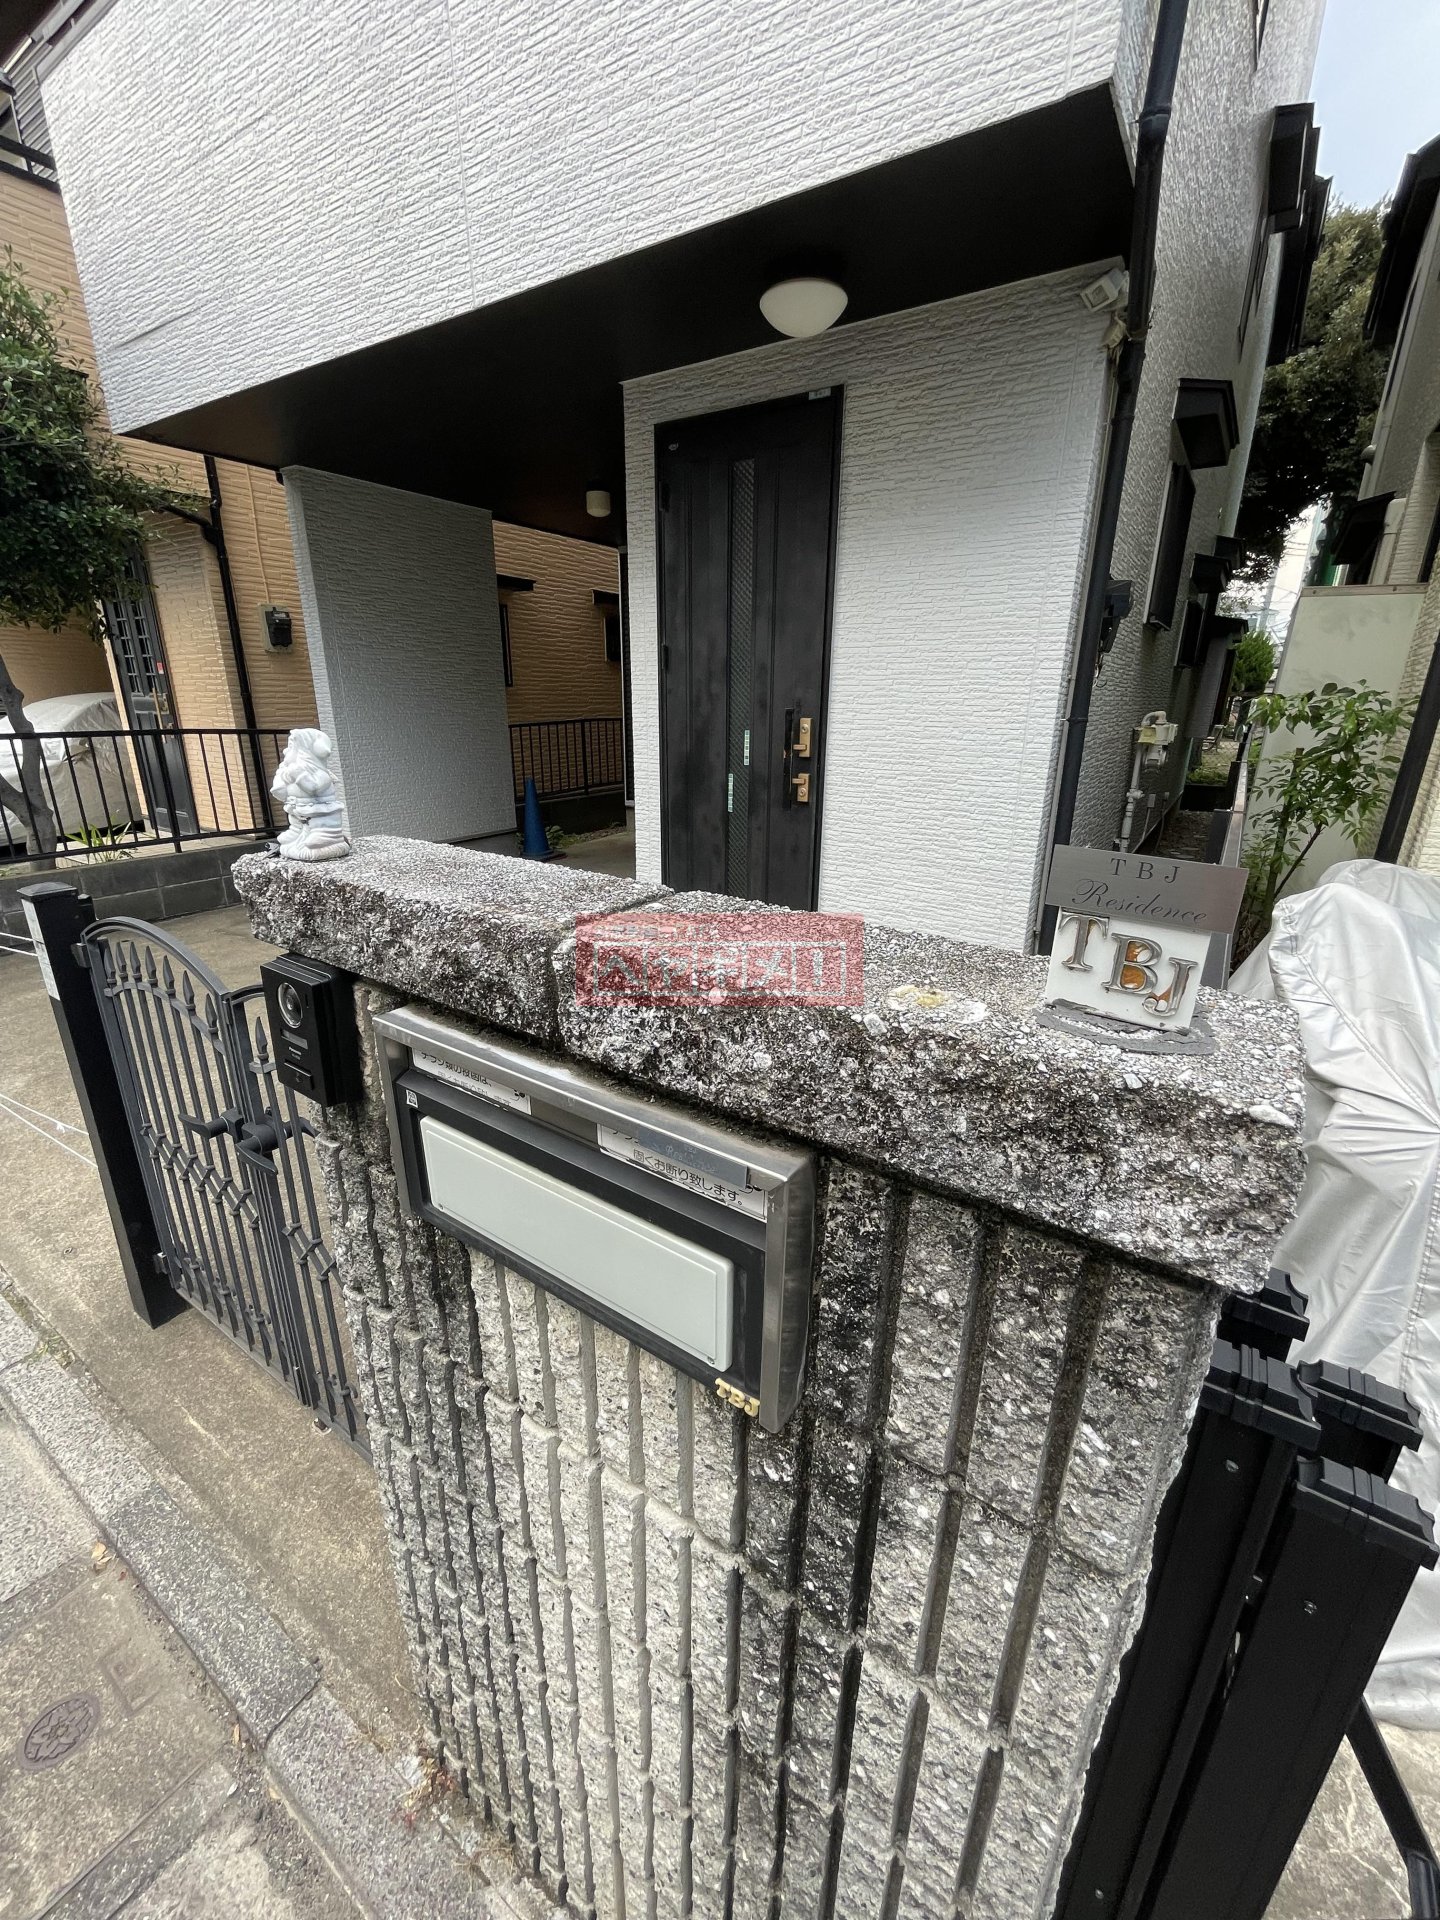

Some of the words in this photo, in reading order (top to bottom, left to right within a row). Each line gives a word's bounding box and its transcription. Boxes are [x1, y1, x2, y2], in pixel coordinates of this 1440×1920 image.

[1071, 878, 1208, 923] Residence
[1058, 912, 1199, 1018] TBJ
[714, 1377, 761, 1418] TBJ
